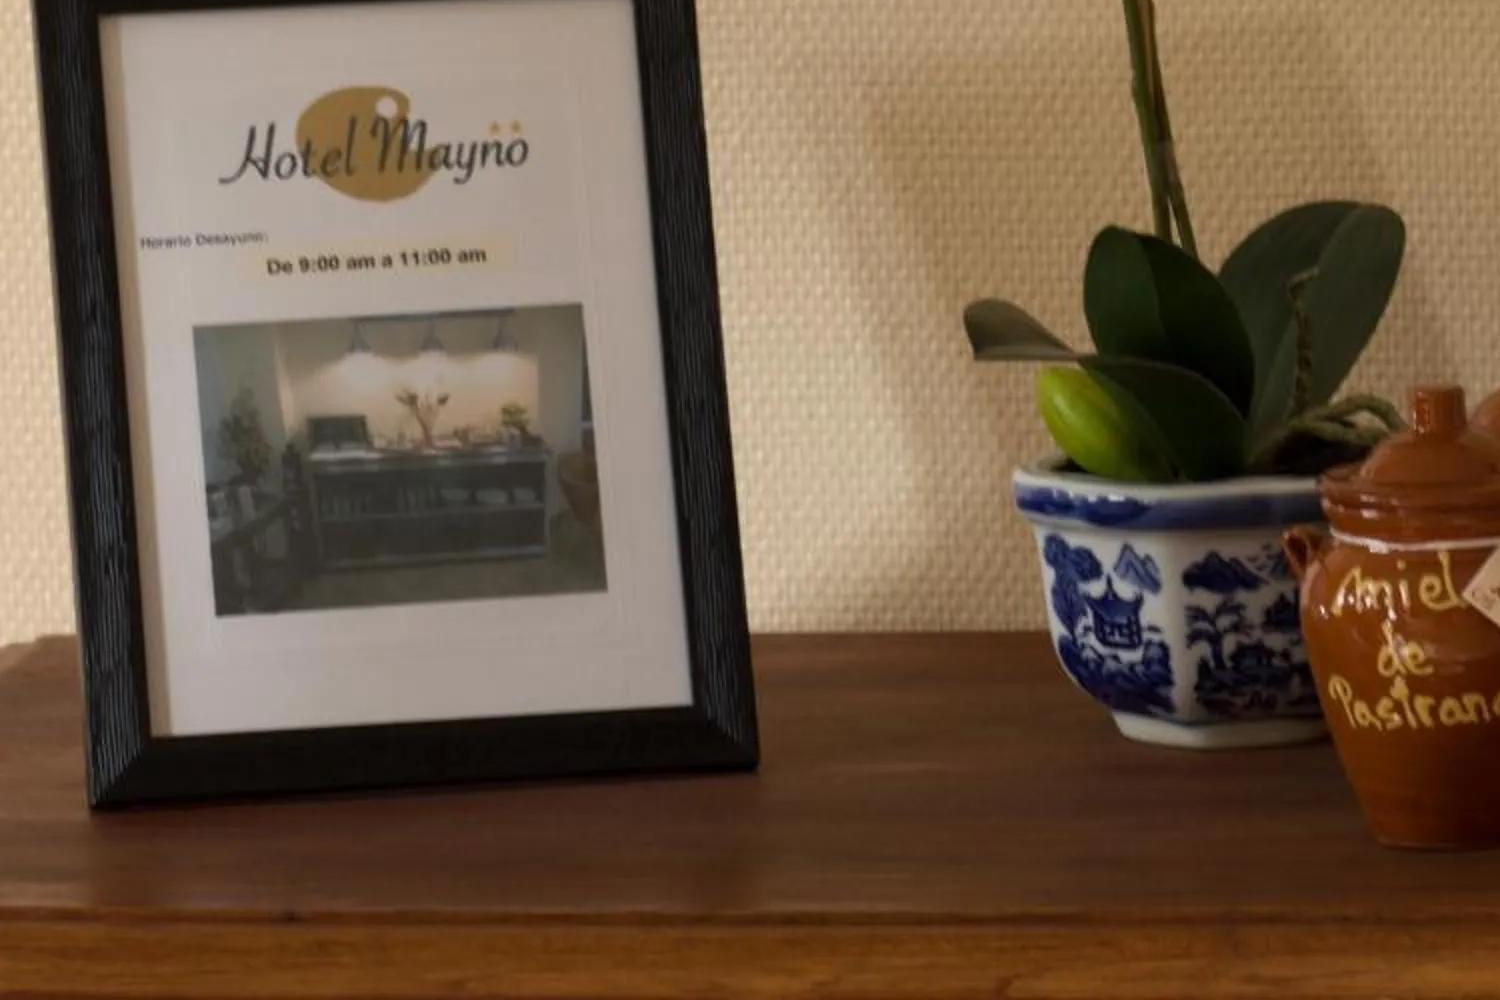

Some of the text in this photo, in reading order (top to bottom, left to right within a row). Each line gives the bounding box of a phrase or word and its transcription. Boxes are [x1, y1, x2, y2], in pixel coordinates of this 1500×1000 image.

[219, 117, 357, 184] Hotel
[266, 248, 487, 276] De 9:00 am a 11:00 am
[1377, 618, 1434, 677] de
